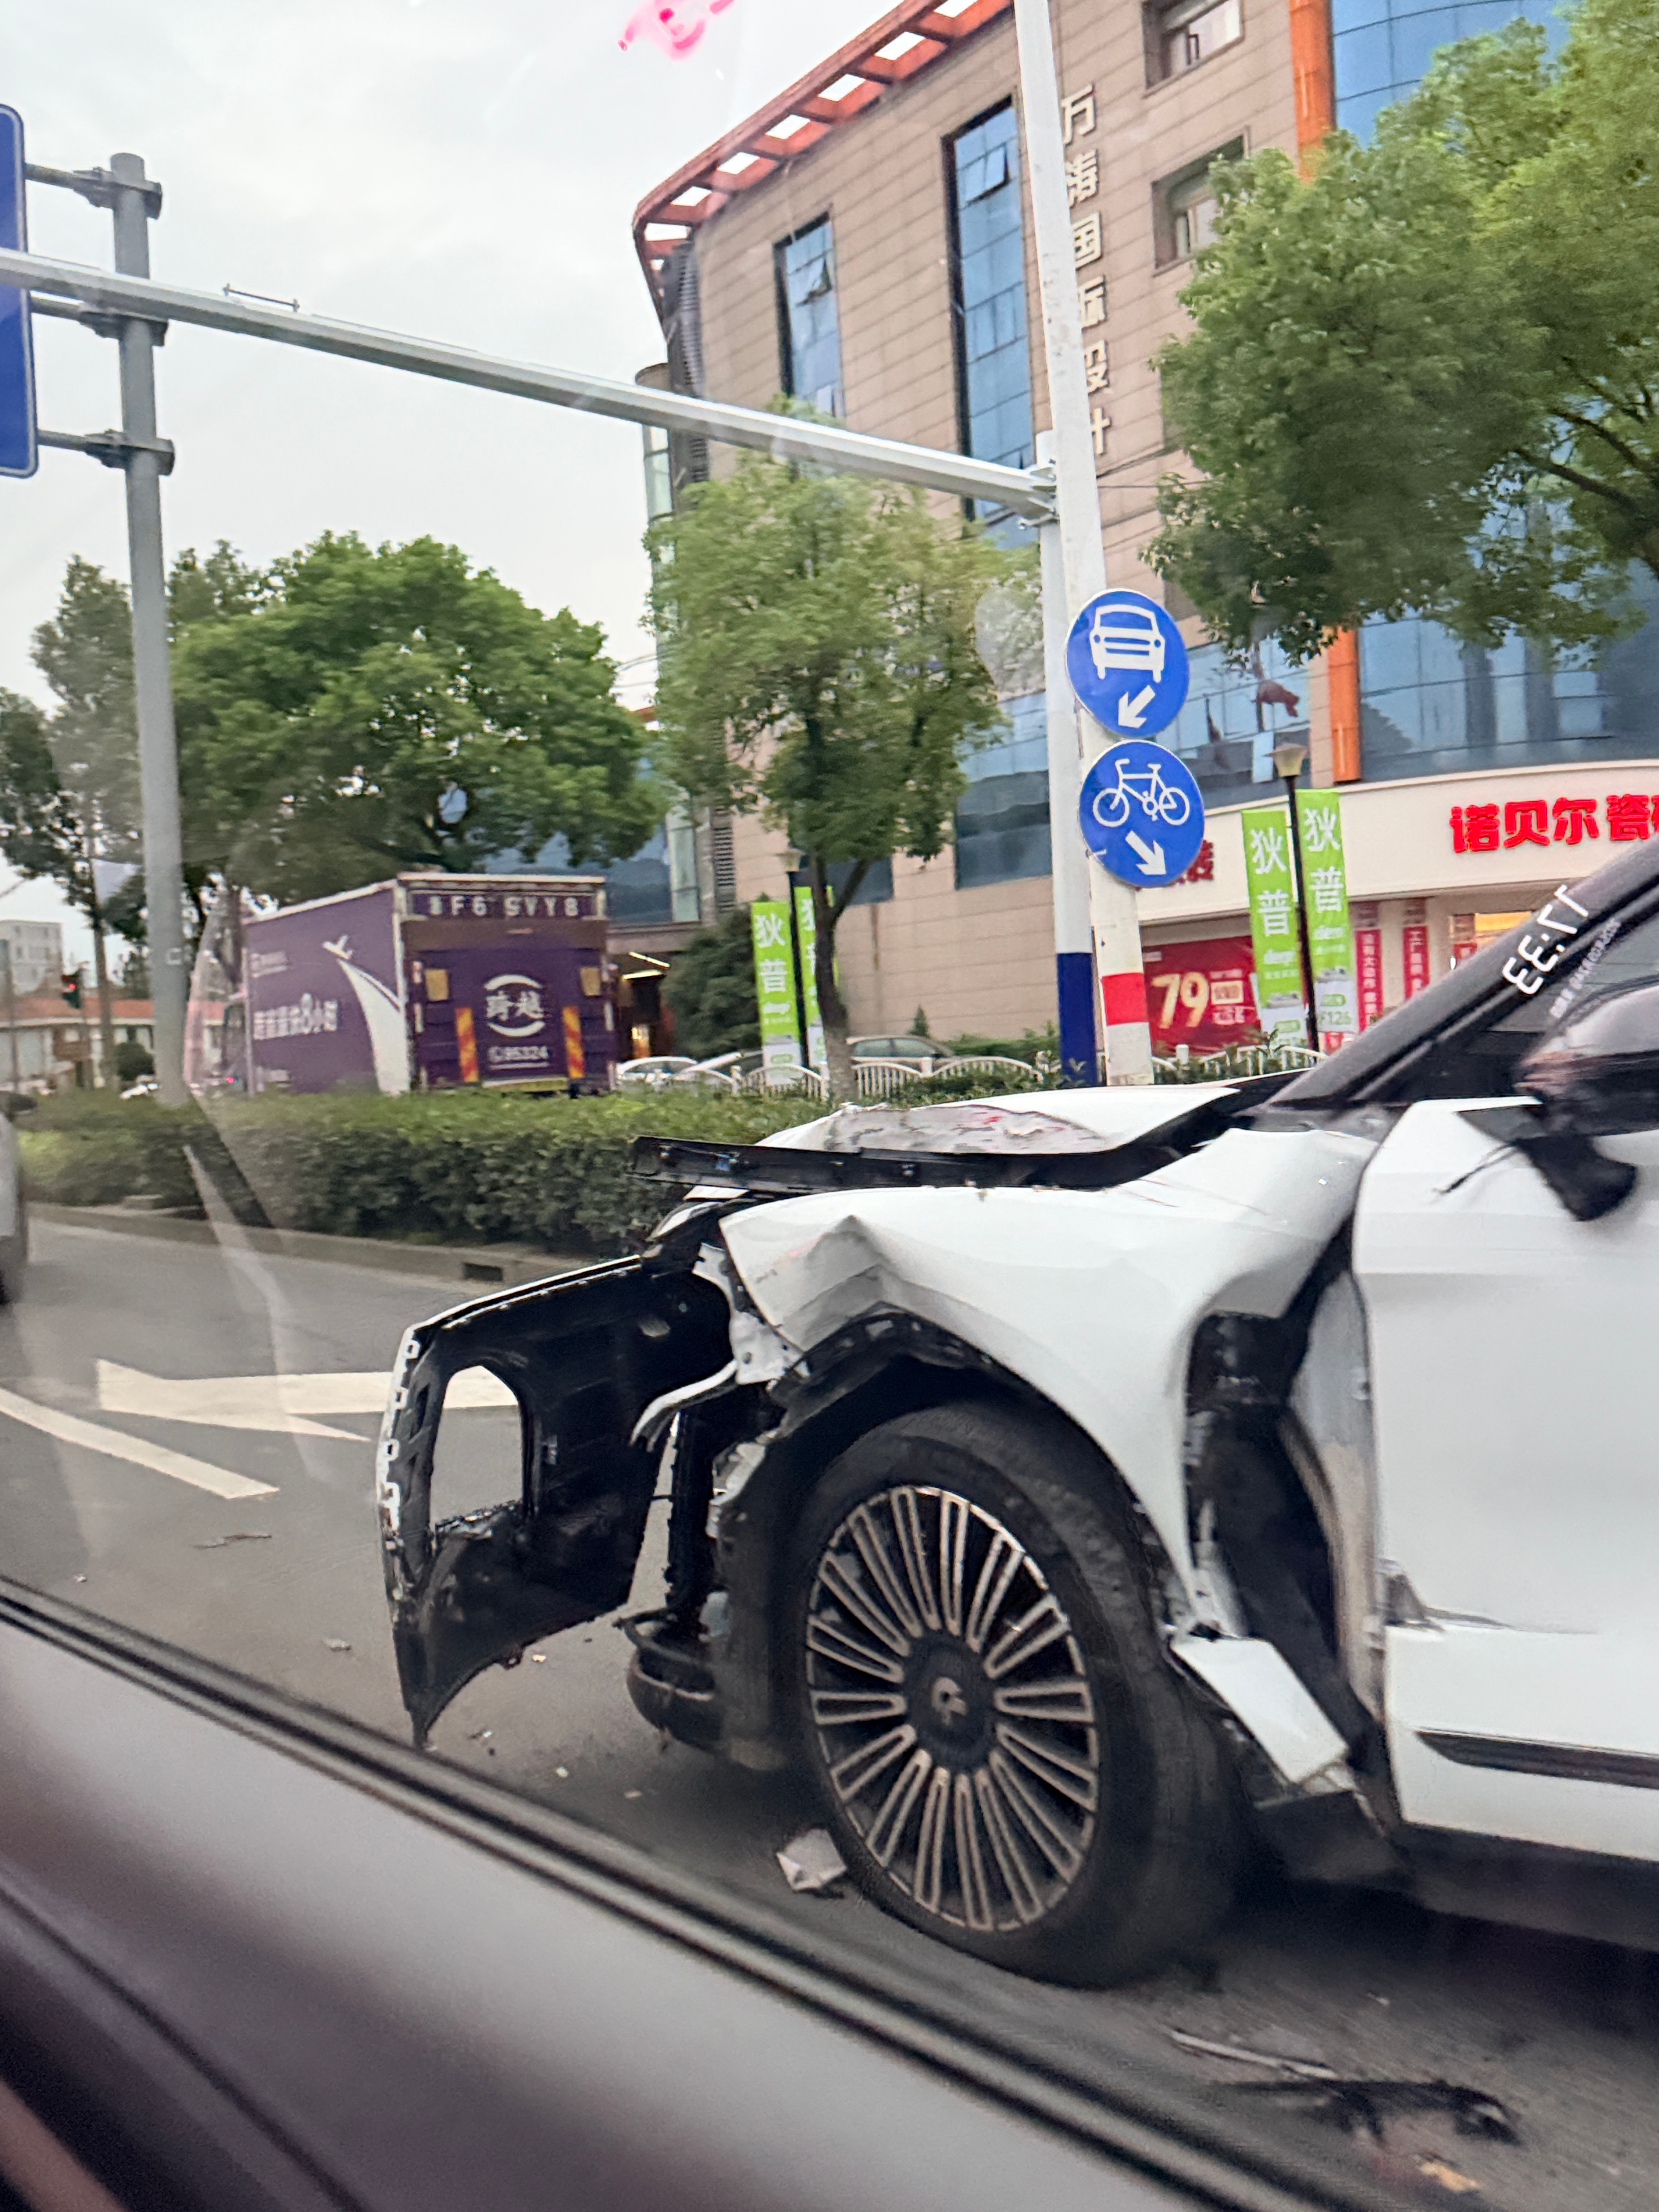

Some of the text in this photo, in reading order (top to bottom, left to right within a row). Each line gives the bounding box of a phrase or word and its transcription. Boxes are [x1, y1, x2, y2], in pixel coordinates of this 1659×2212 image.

[1304, 805, 1345, 914] 狄普
[1449, 793, 1659, 853] 诺贝尔瓷
[1250, 827, 1291, 937] 狄普
[754, 912, 787, 993] 狄普
[1151, 972, 1209, 1029] 79
